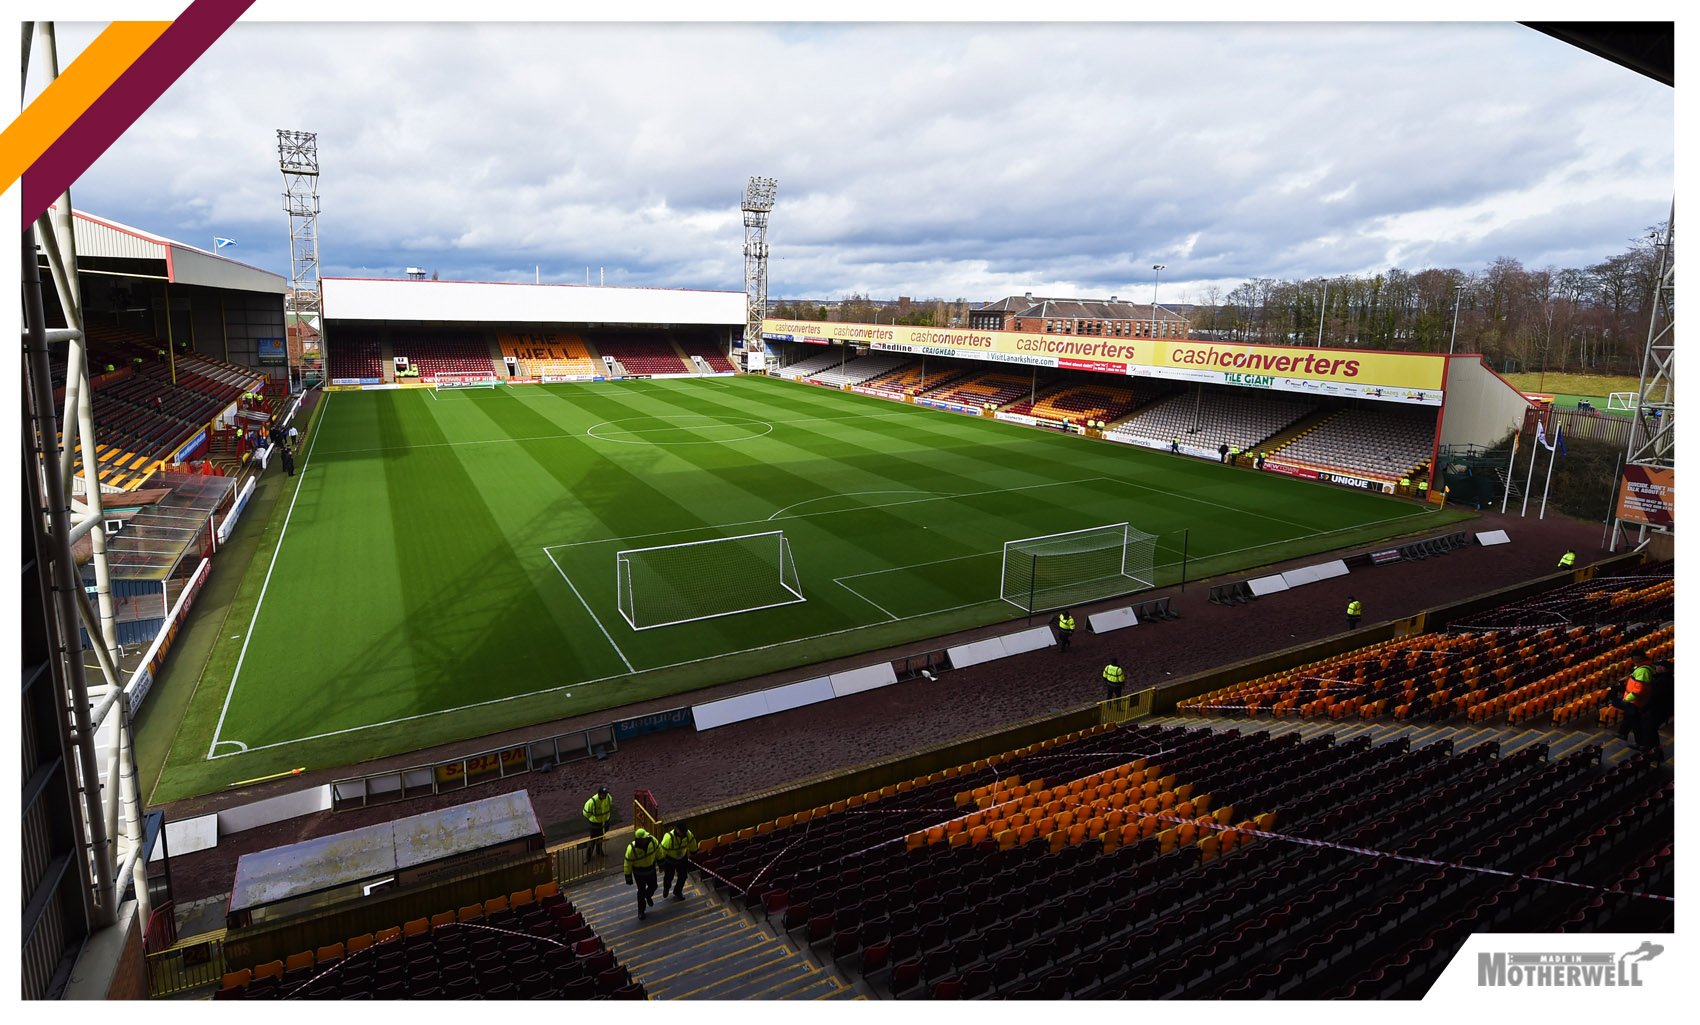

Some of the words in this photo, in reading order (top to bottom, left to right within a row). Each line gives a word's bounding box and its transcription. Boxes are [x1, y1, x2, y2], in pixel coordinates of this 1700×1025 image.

[834, 326, 893, 340] cashconverters
[911, 330, 992, 347] cashconverters
[882, 343, 913, 352] Redline
[922, 346, 956, 356] CRAIGHEAD
[1016, 336, 1135, 359] cashconverters
[991, 352, 1054, 366] VisitLanarkshire.com
[1172, 346, 1361, 378] cashconverters
[1331, 475, 1369, 489] UNIQUE
